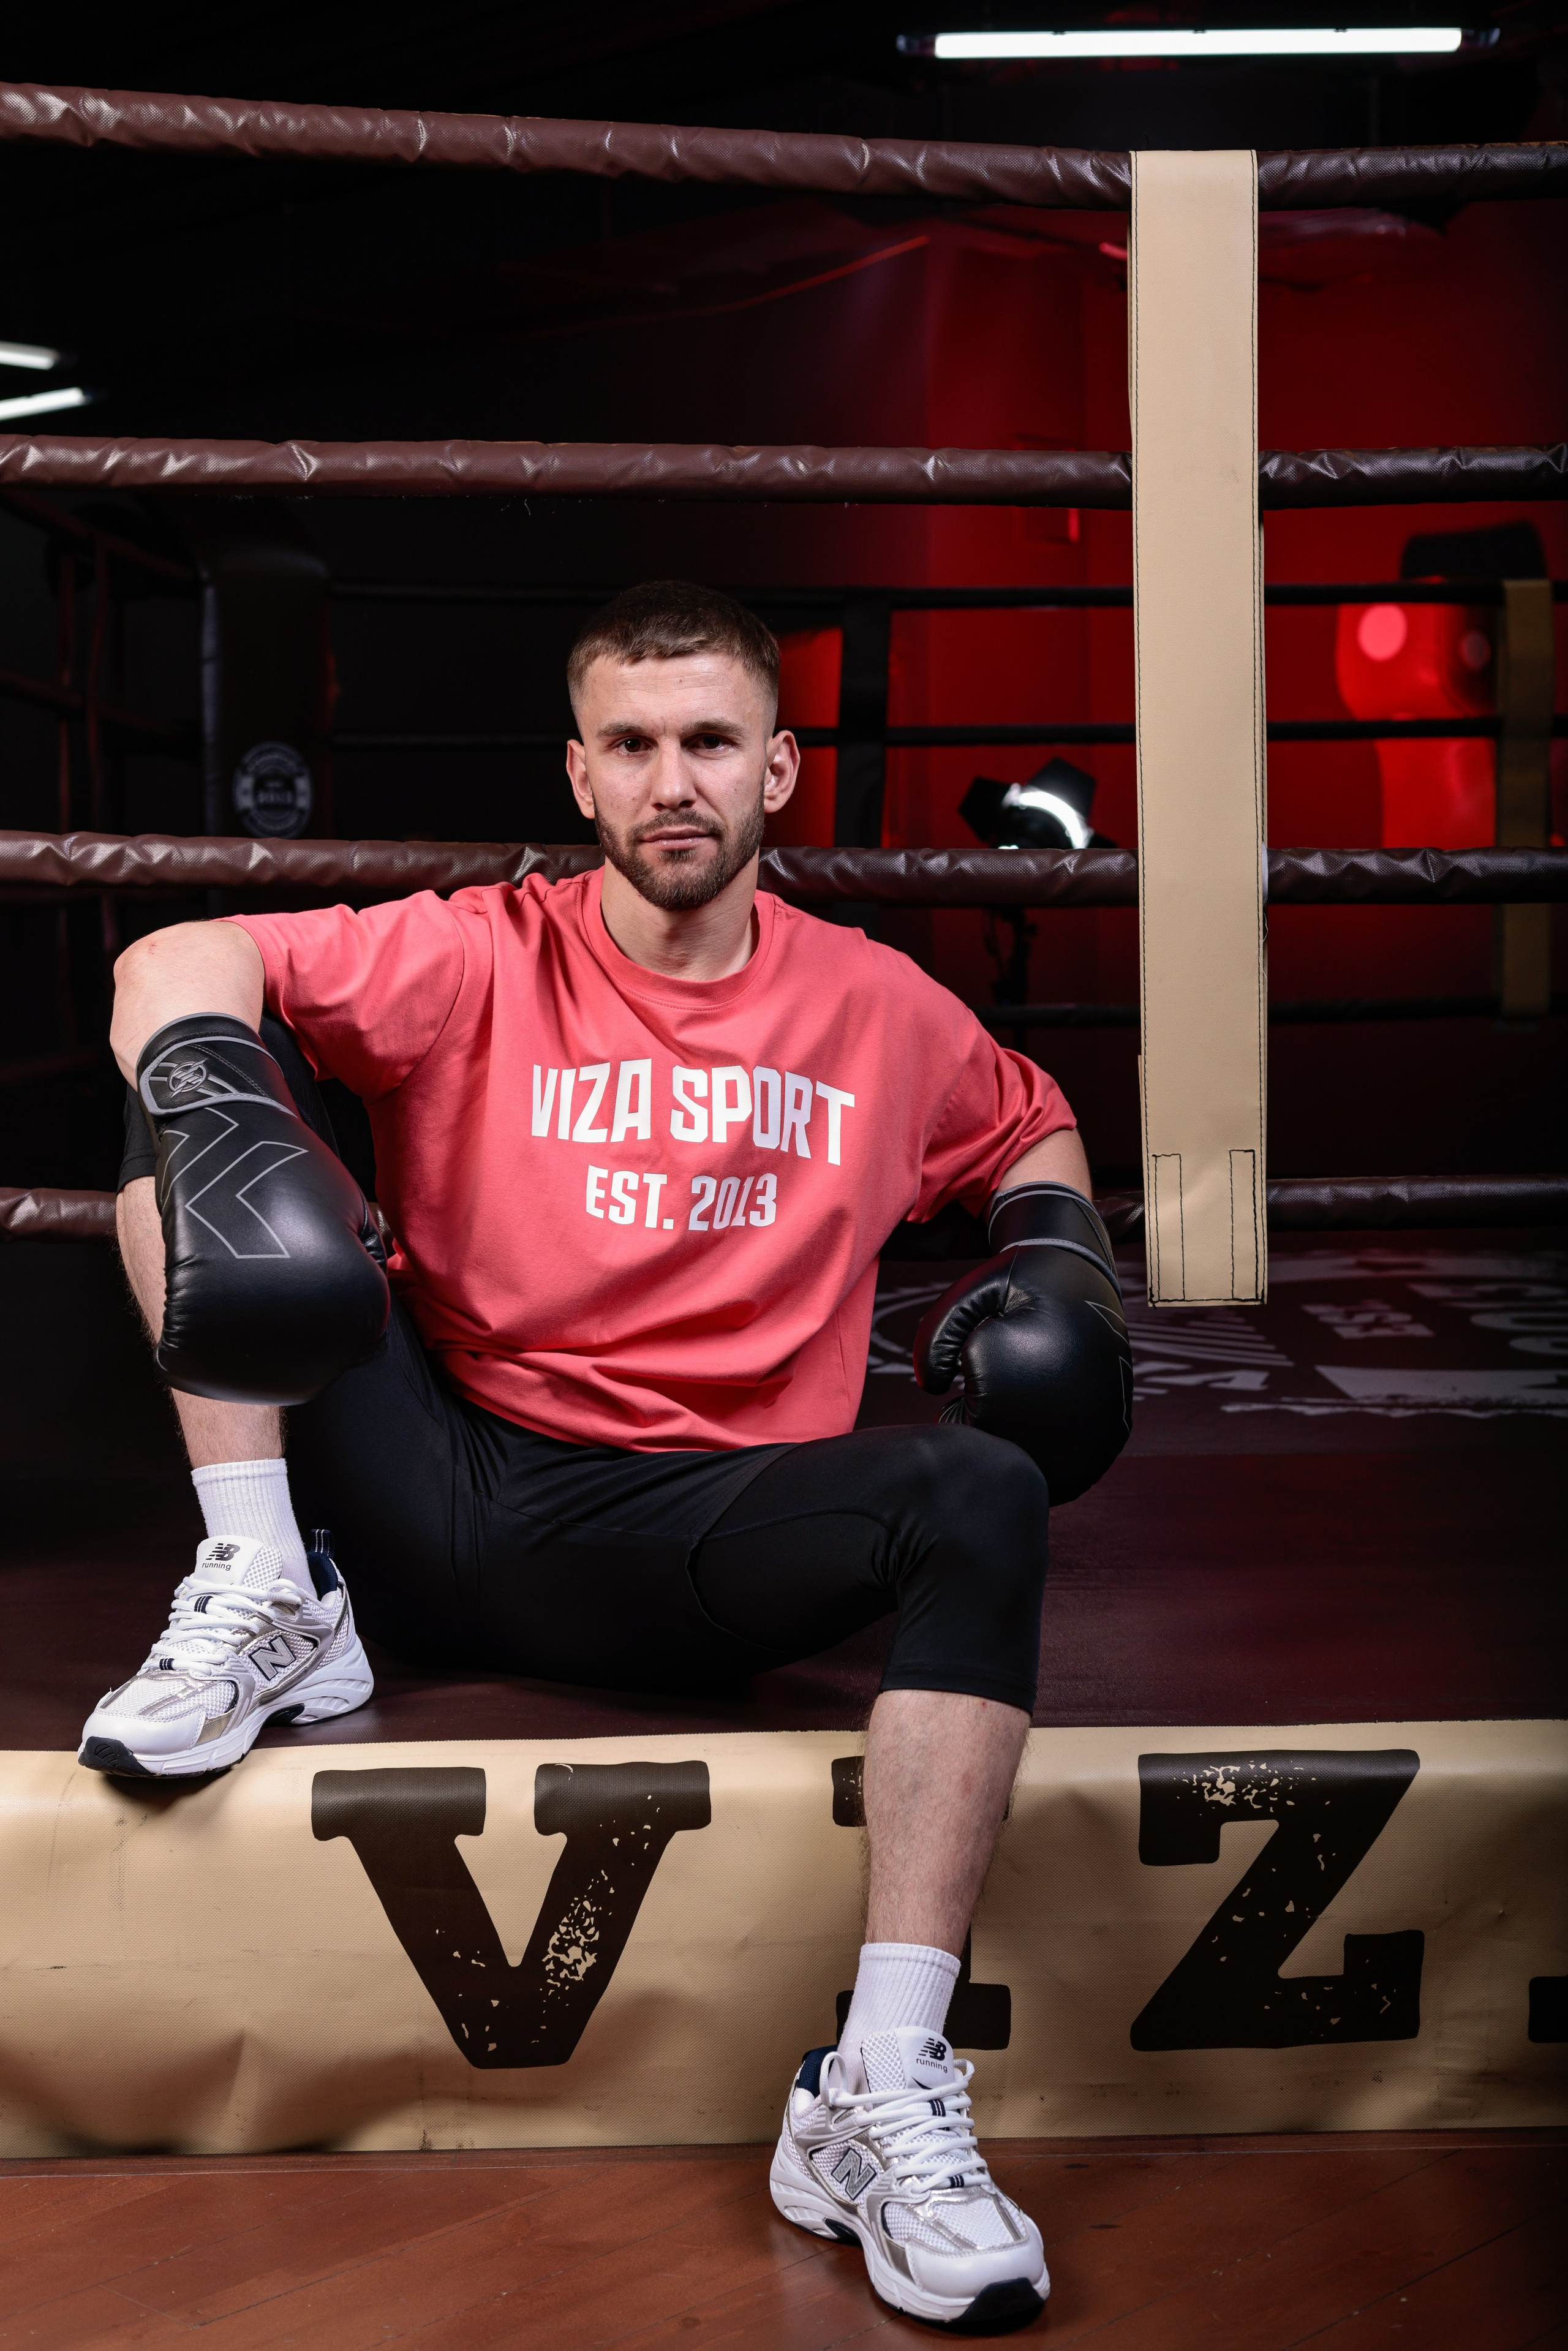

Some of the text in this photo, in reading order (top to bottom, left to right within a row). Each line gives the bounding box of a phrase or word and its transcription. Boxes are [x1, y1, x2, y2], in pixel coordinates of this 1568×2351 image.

[532, 1059, 855, 1166] VIZA SPORT
[586, 1164, 778, 1231] EST. 2013
[202, 1562, 232, 1571] running
[248, 1636, 296, 1681] N
[916, 2058, 948, 2074] running
[831, 2147, 877, 2201] N
